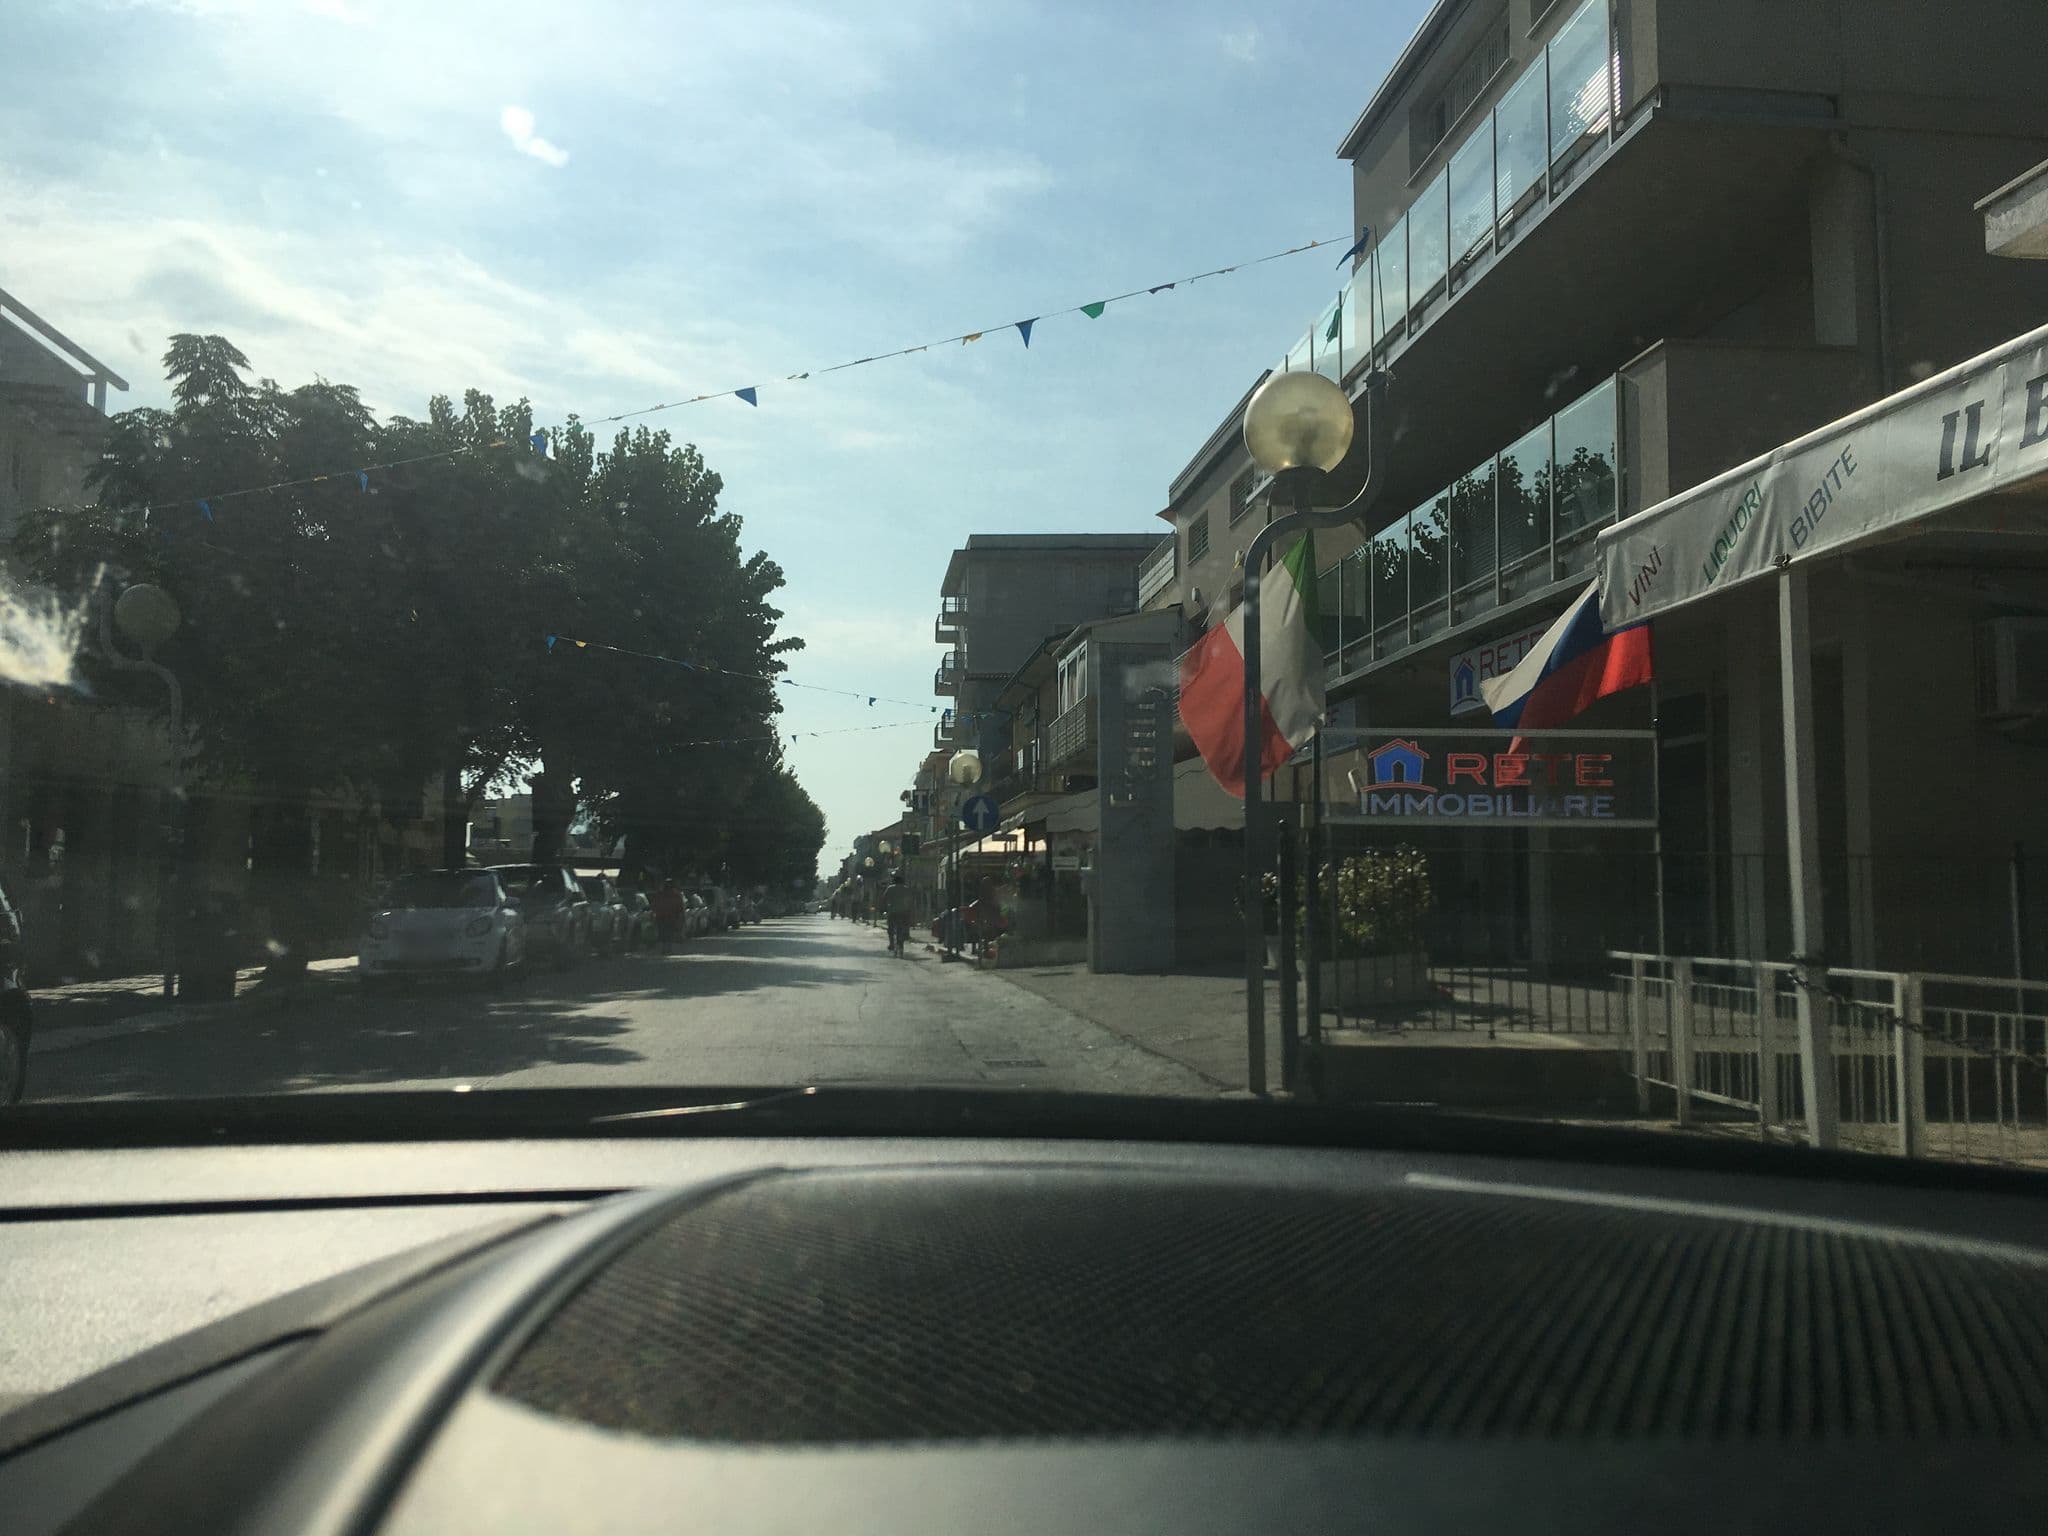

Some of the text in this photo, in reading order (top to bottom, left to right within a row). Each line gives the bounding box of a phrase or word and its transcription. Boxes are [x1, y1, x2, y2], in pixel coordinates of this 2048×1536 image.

[1937, 399, 1991, 481] IL
[1628, 444, 1858, 606] VINI LIQUORI BIBITE
[1447, 753, 1614, 788] RETE
[1360, 793, 1616, 817] IMMOBILIARE
